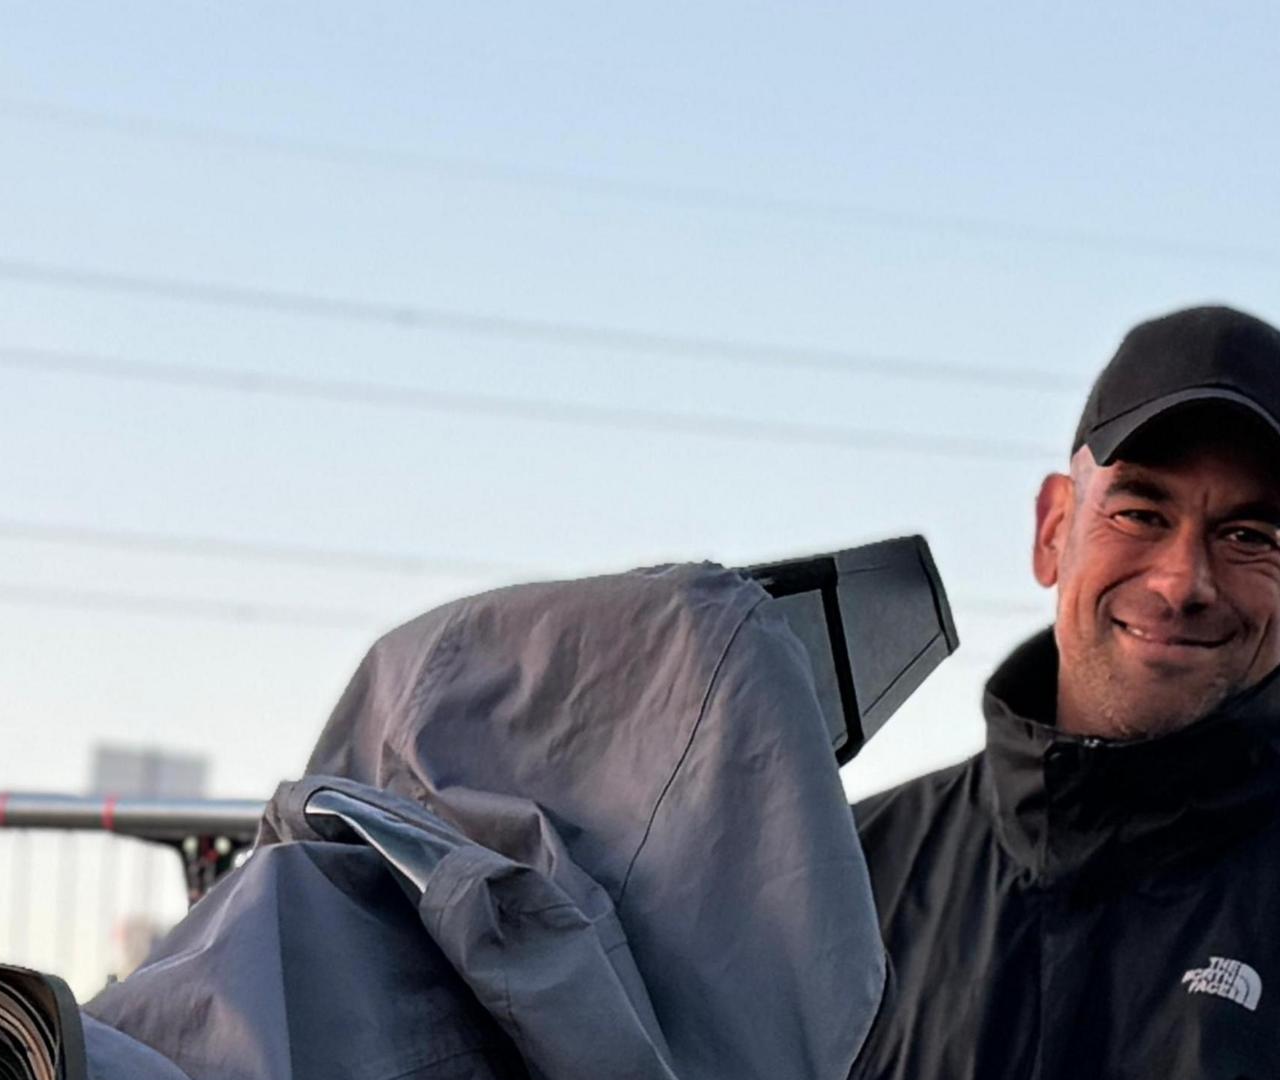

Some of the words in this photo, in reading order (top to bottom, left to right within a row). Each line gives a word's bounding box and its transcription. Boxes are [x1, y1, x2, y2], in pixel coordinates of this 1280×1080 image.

[1210, 957, 1241, 973] THE
[1182, 968, 1234, 986] NORTH
[1188, 980, 1230, 997] FACE
